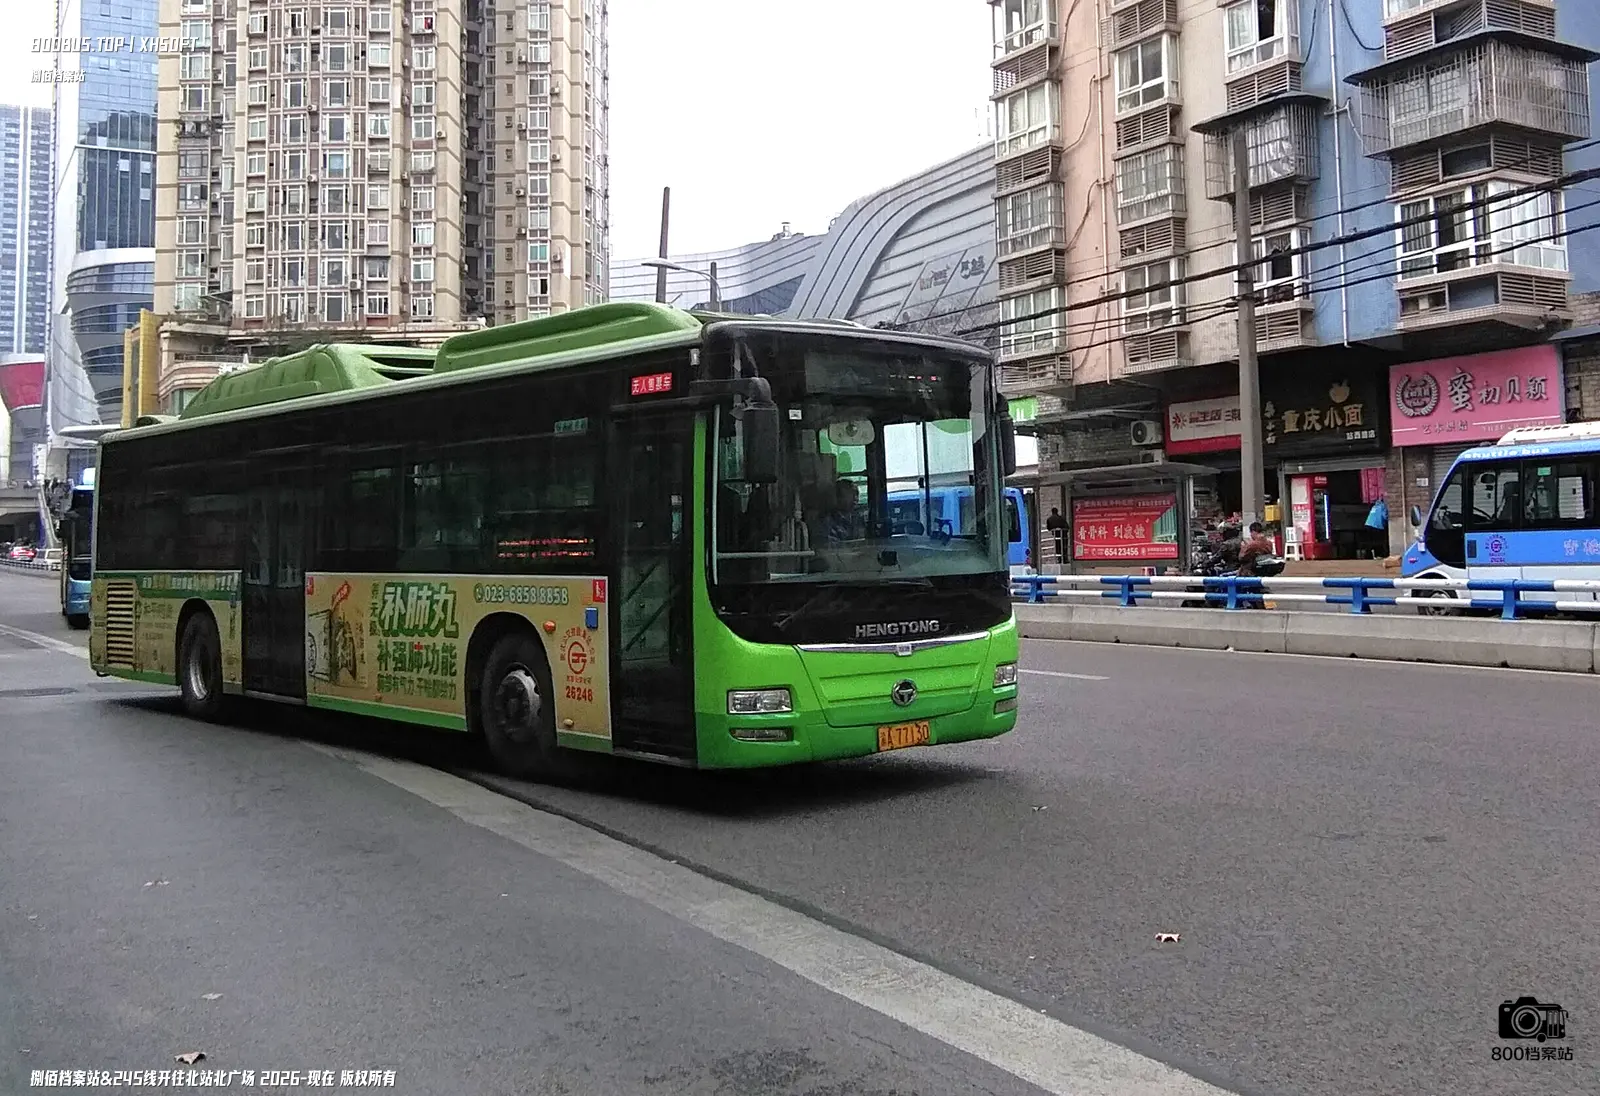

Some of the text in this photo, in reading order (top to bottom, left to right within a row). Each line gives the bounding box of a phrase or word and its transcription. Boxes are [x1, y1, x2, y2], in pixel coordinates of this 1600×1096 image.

[1282, 404, 1364, 433] 重庆小面
[1104, 547, 1139, 556] 65423456
[380, 583, 458, 636] 补肺丸
[855, 620, 940, 638] HENGTONG
[566, 686, 593, 702] 26248
